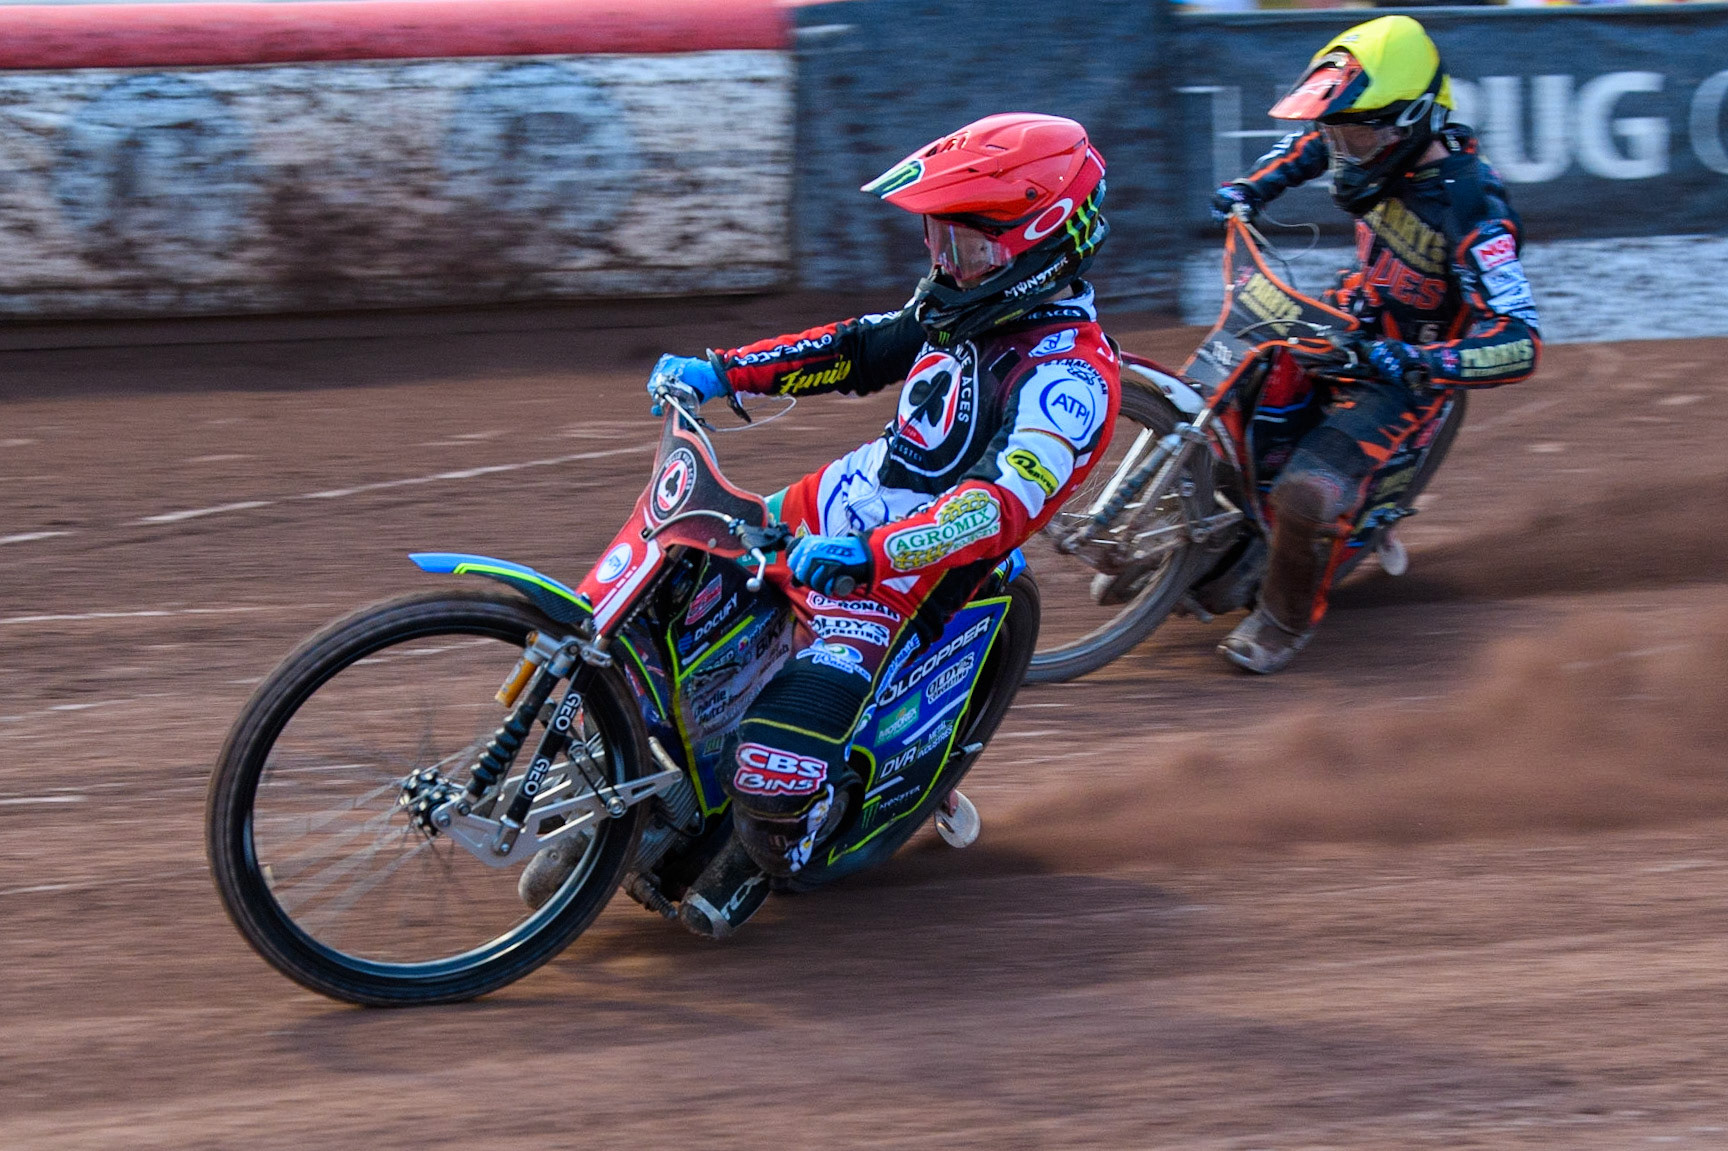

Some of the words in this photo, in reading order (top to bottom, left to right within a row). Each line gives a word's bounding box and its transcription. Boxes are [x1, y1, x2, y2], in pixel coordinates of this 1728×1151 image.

[957, 376, 974, 423] ACES
[1050, 392, 1091, 427] ATPI
[895, 506, 991, 552] AGROMIX
[693, 592, 738, 642] DOCUFY
[879, 616, 991, 706] OLCOPPER
[737, 772, 815, 791] BINS
[740, 747, 823, 779] CBS
[880, 746, 917, 779] DVR
